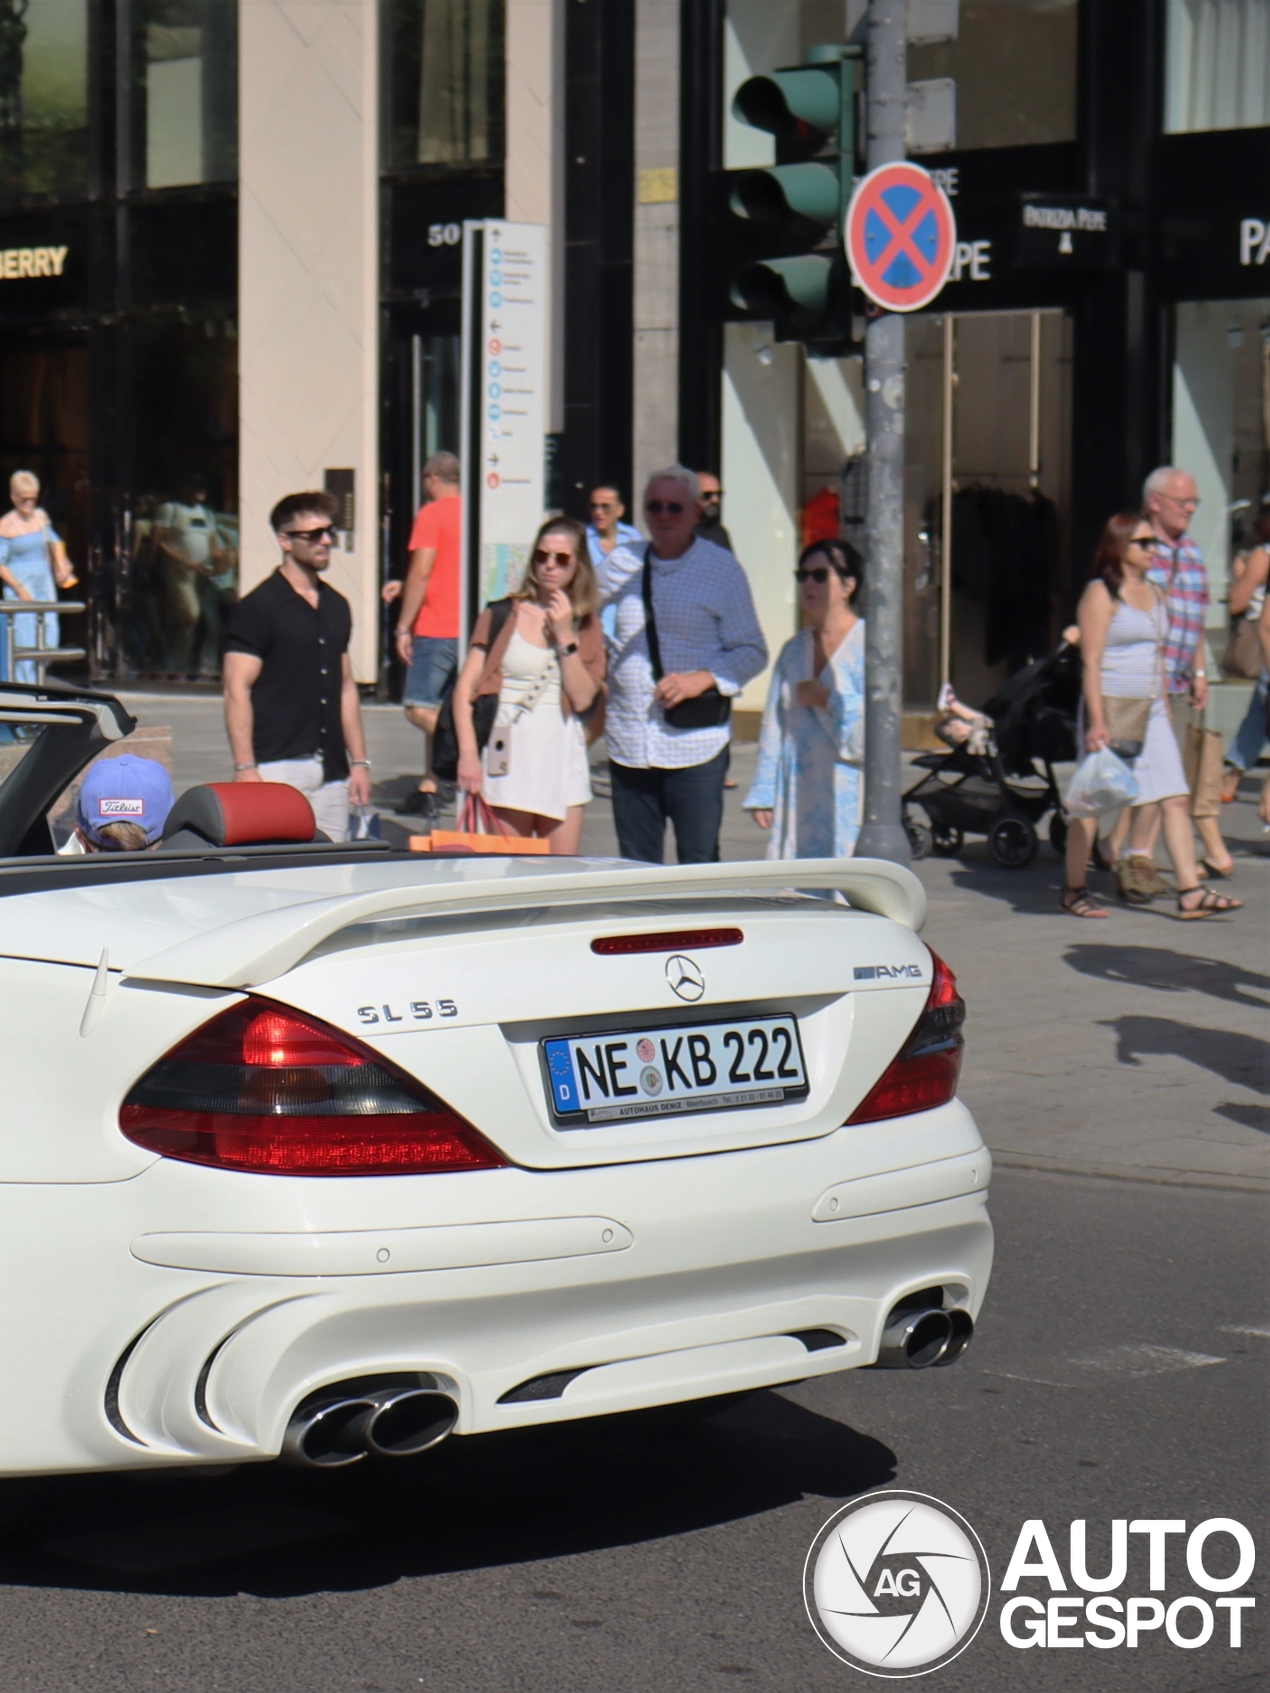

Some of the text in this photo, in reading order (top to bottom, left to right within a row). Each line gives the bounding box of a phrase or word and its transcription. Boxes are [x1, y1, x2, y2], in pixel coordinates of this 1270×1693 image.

[427, 223, 461, 247] 50
[102, 801, 140, 813] Titleist
[876, 964, 922, 979] AMG
[357, 999, 458, 1024] SL 55
[575, 1027, 798, 1100] NE KB 222
[559, 1084, 570, 1100] D
[619, 1104, 659, 1115] AUTOHAUS
[661, 1101, 682, 1111] DENIZ
